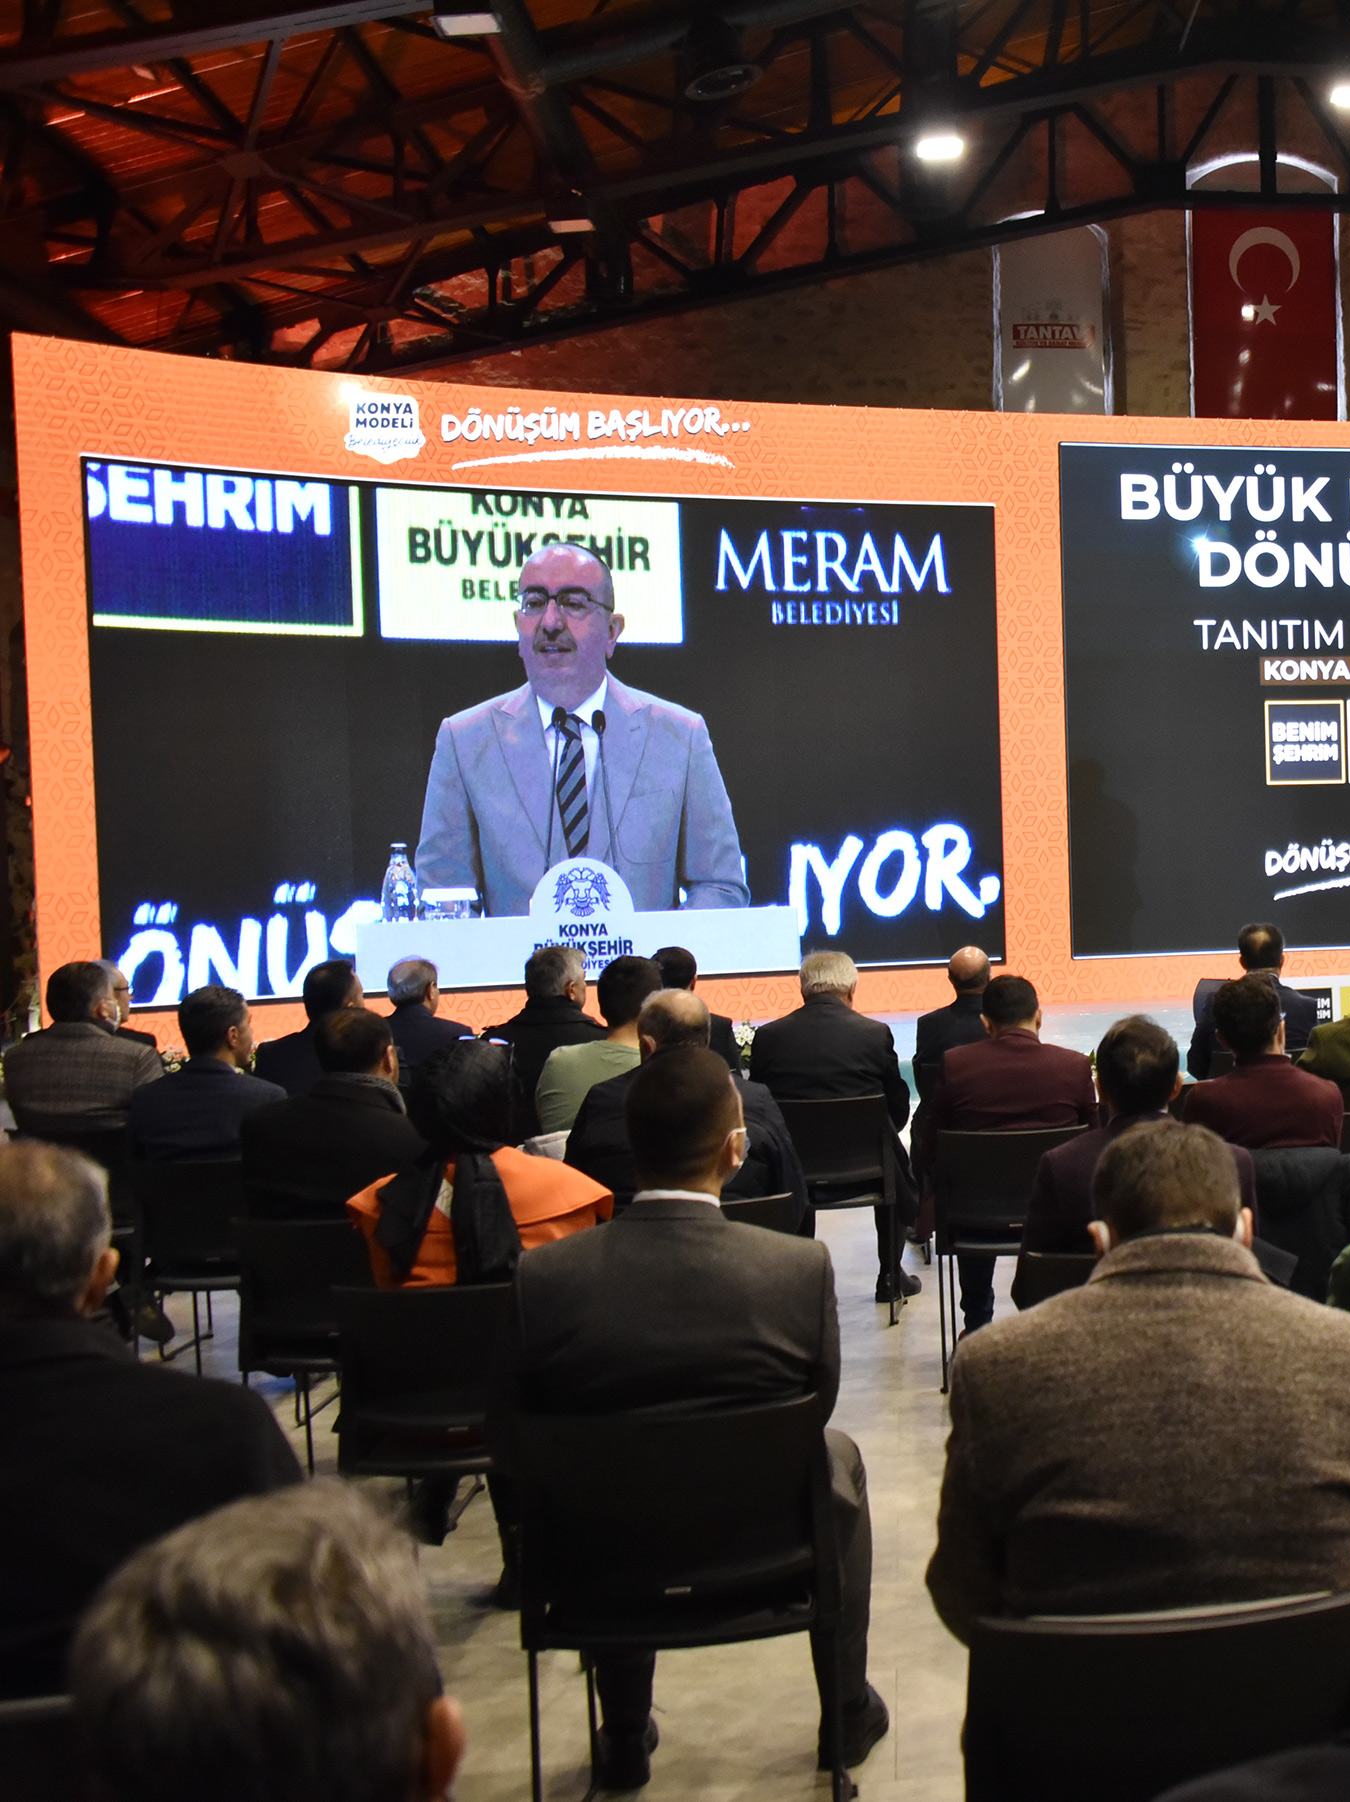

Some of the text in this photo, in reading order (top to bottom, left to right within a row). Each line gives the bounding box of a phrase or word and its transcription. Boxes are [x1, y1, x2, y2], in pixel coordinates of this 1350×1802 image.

[356, 402, 413, 415] KONYA
[441, 406, 580, 445] DÖNÜŞÜM
[1120, 463, 1332, 523] BÜYÜK
[715, 528, 953, 594] MERAM
[1193, 618, 1345, 650] TANITIM
[1264, 659, 1350, 682] KONYA
[558, 923, 609, 938] KONYA
